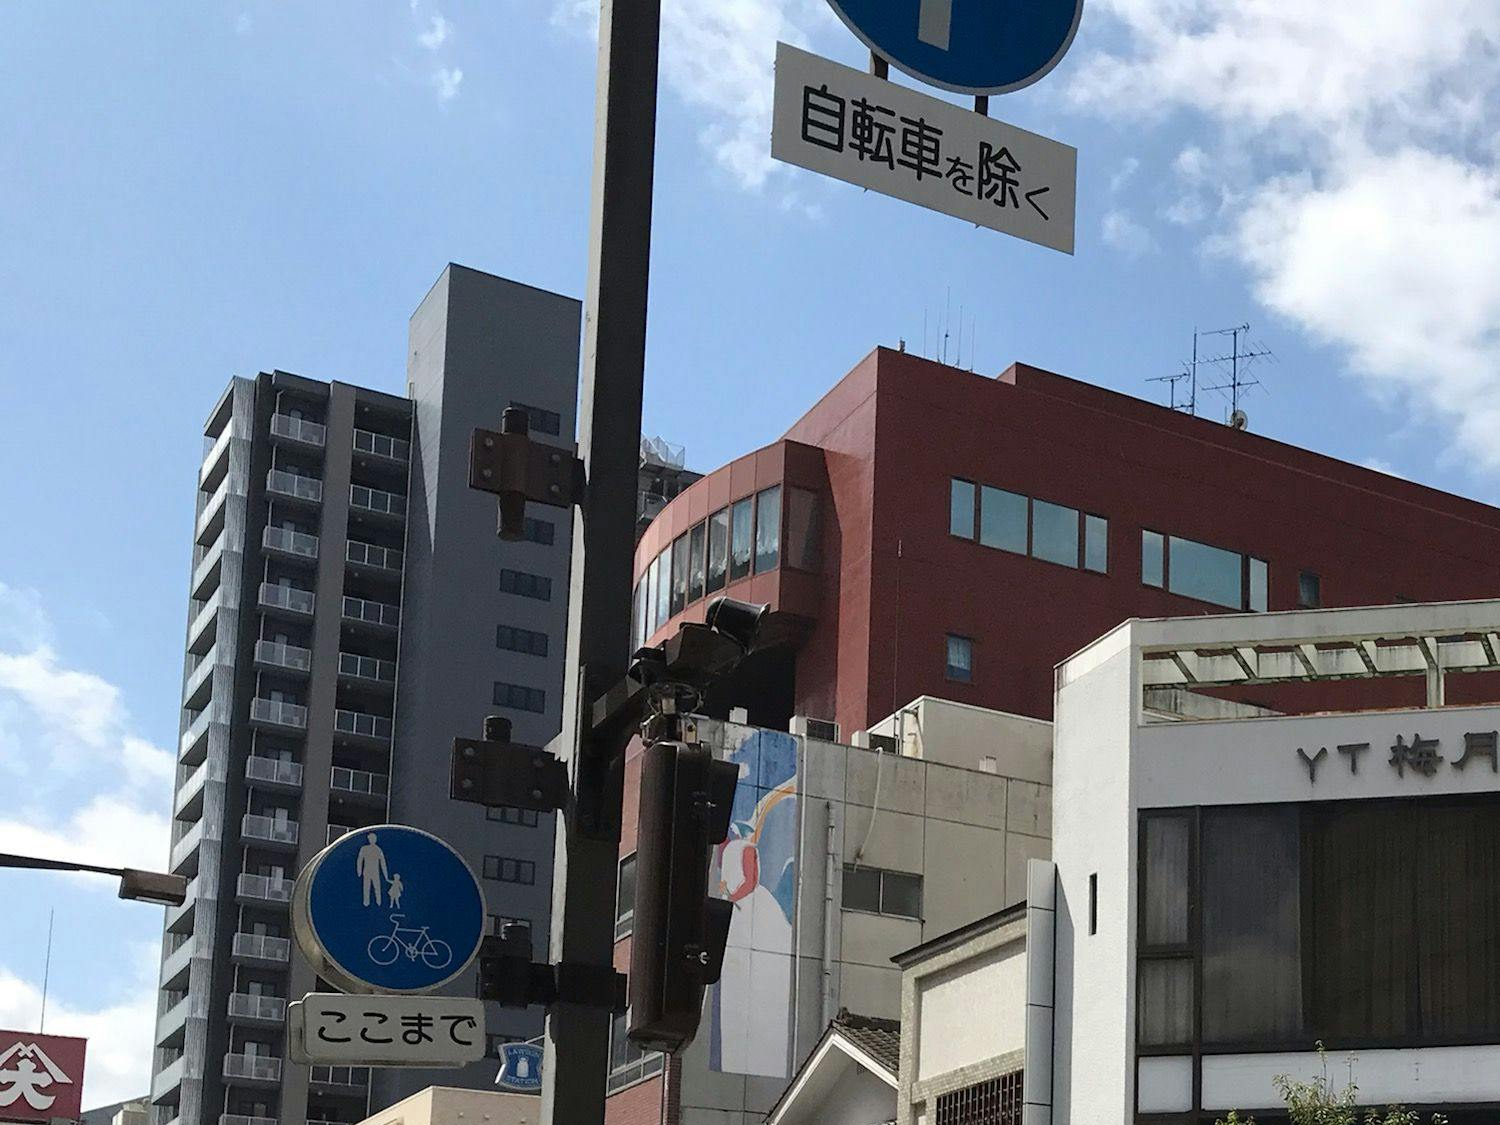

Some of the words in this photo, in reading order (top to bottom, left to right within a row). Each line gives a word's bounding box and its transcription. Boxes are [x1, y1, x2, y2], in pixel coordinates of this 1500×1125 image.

[801, 84, 1050, 221] 自転車を除く
[318, 1012, 477, 1046] ここまで
